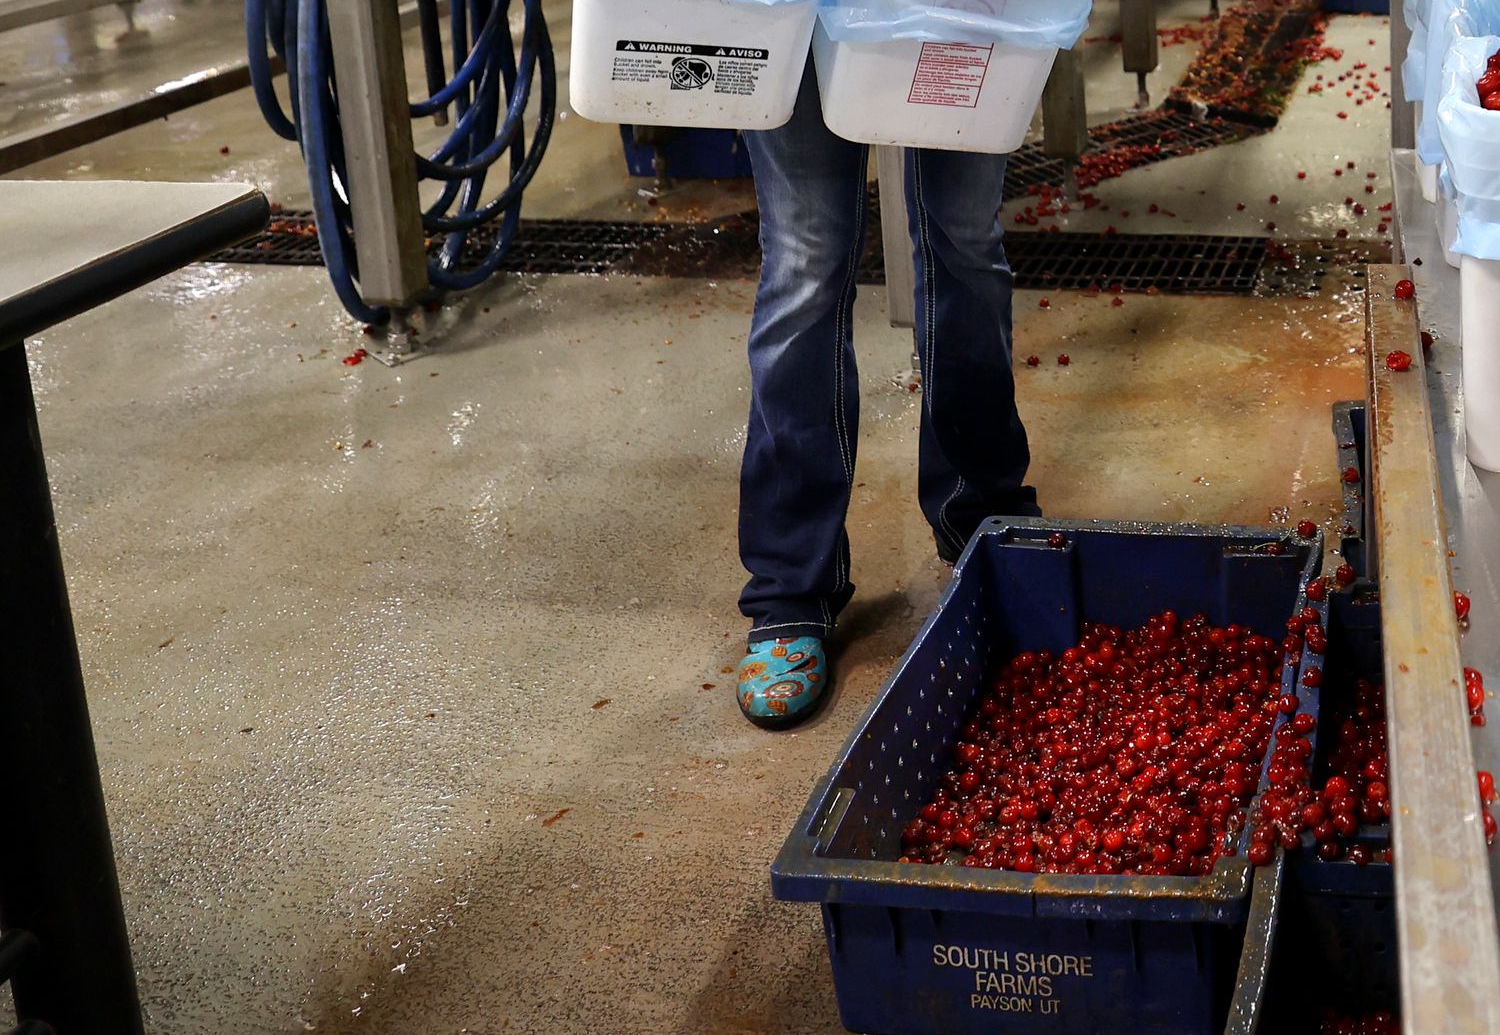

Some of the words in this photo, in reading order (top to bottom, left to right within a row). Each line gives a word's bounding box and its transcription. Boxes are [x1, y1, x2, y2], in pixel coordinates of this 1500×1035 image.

[639, 43, 692, 54] WARNING
[729, 49, 763, 58] AVISO
[933, 944, 1009, 971] SOUTH
[1015, 952, 1094, 977] SHORE
[975, 971, 1053, 997] FARMS
[971, 994, 1032, 1013] PAYSON
[1040, 999, 1061, 1014] UT
